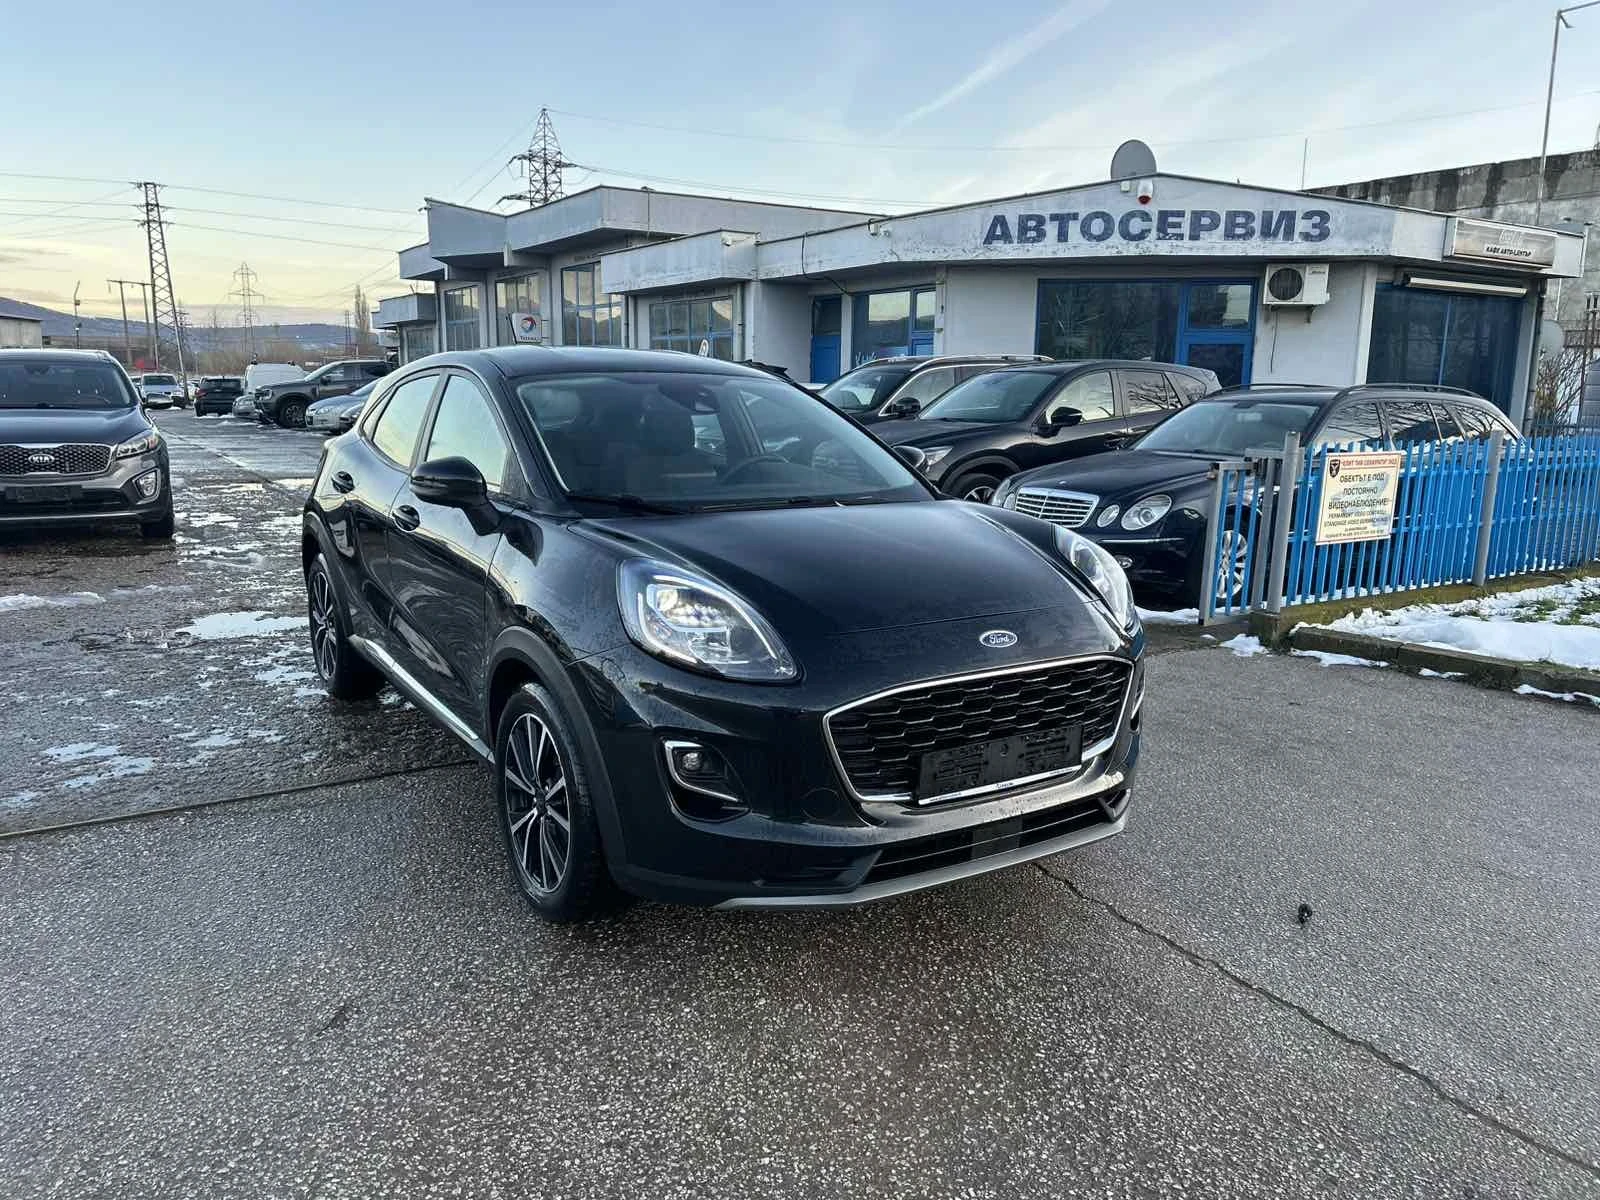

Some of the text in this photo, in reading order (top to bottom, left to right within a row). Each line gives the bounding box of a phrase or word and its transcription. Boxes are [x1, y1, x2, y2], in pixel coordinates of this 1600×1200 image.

[983, 209, 1331, 245] АВТОСЕРВИЗ
[1340, 472, 1385, 483] ОБЕКТЪТ Е ПОД
[1343, 486, 1378, 496] ПОСТОЯННО
[988, 633, 1010, 645] Ford
